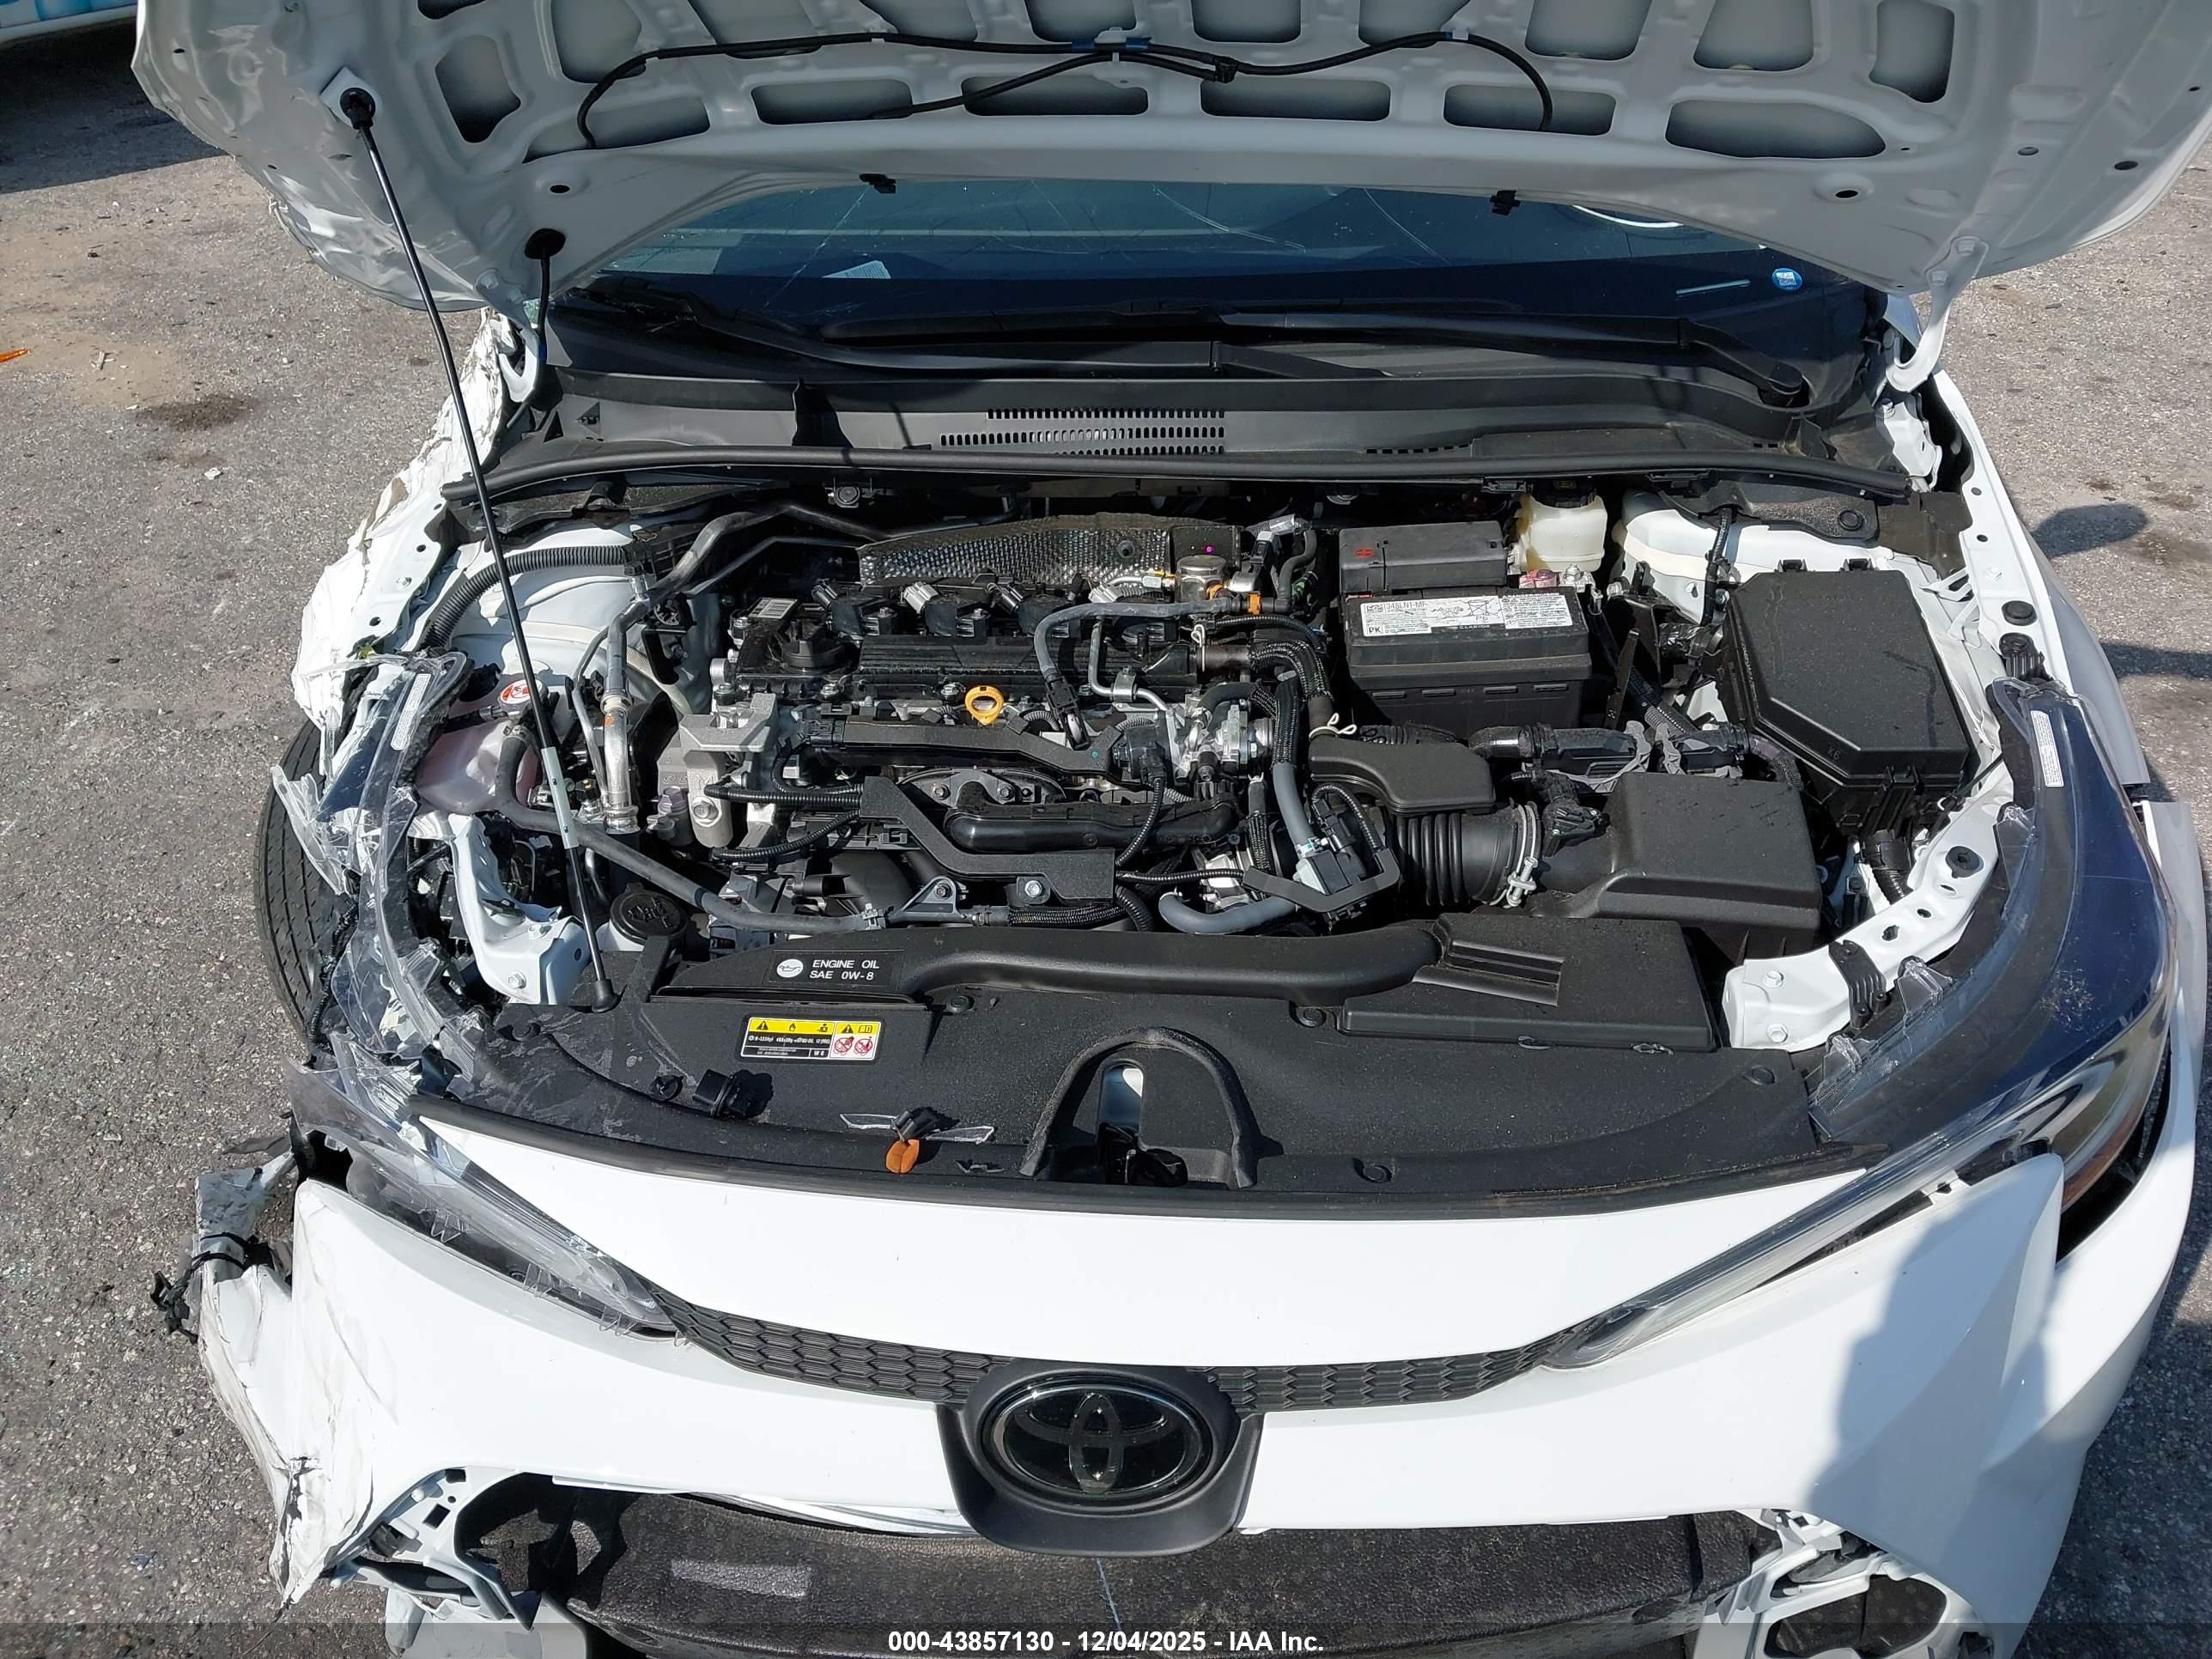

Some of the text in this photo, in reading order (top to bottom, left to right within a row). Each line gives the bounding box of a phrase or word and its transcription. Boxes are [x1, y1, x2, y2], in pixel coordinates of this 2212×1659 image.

[812, 959, 879, 969] ENGINE OIL
[809, 970, 874, 981] SAE 0W-8
